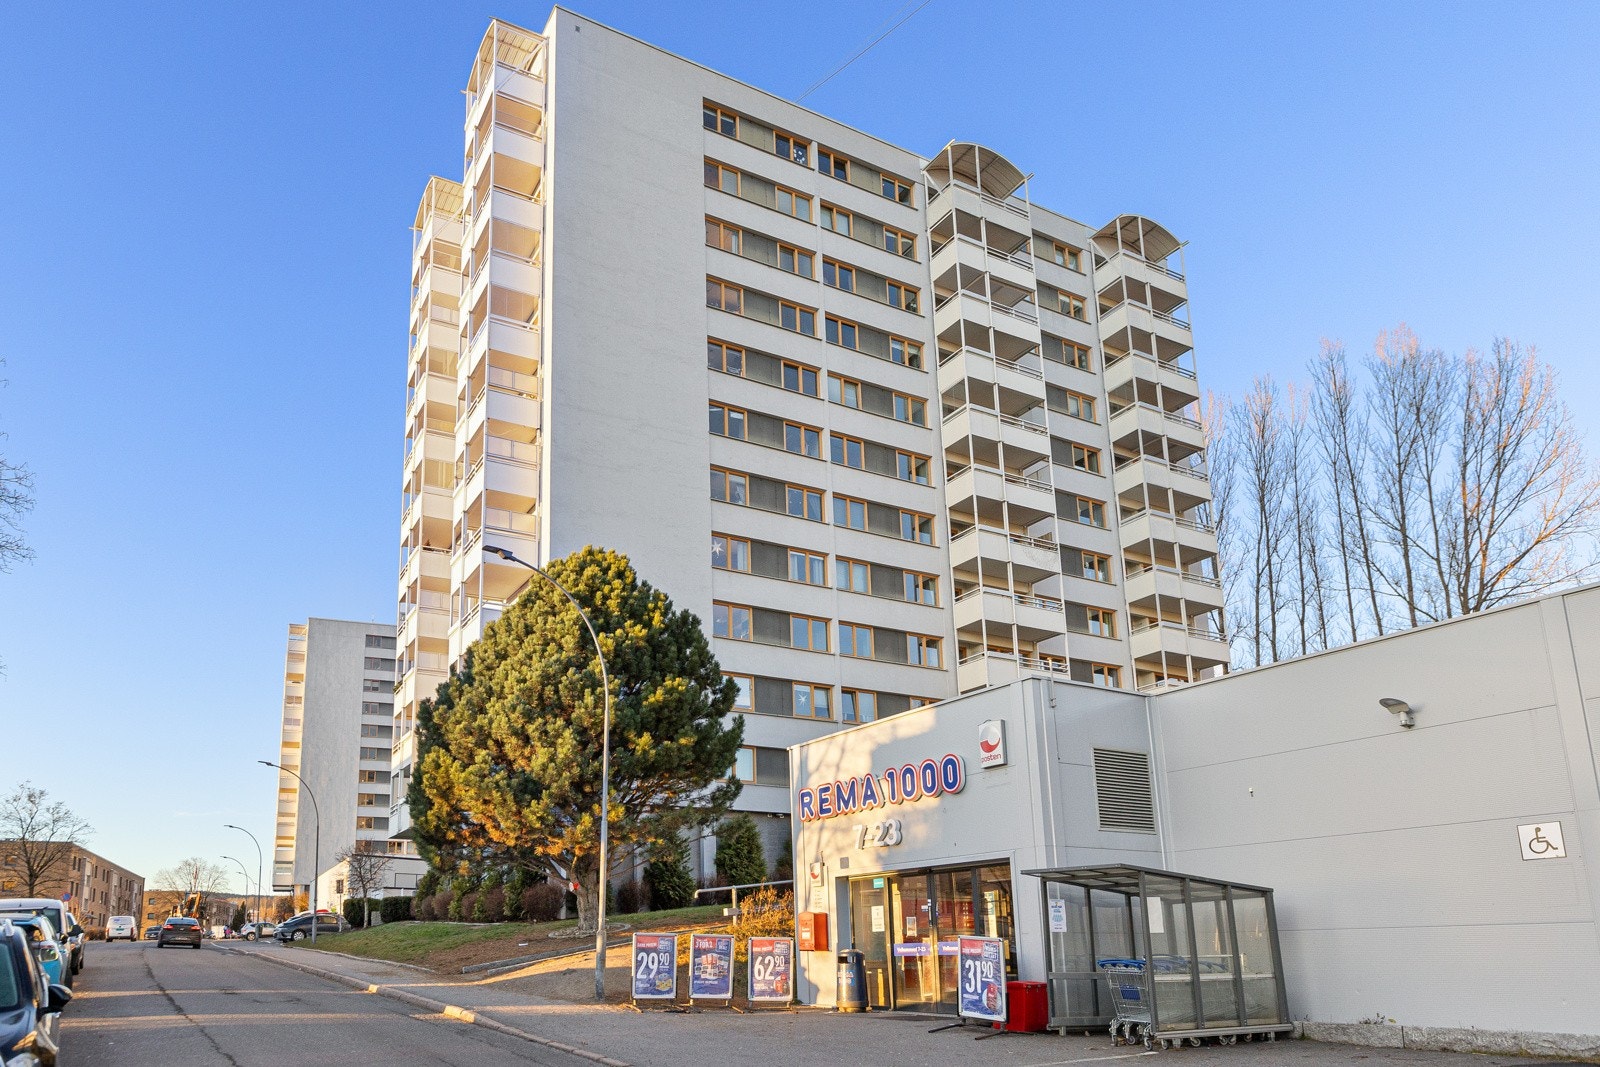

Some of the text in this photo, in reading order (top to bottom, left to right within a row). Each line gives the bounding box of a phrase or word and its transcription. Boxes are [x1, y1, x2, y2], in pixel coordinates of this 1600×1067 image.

[981, 754, 1002, 764] posten
[798, 754, 963, 822] REMA 1000
[852, 818, 902, 850] 7-23
[636, 951, 670, 979] 29 90
[754, 955, 785, 981] 62 90
[965, 959, 993, 993] 31 90
